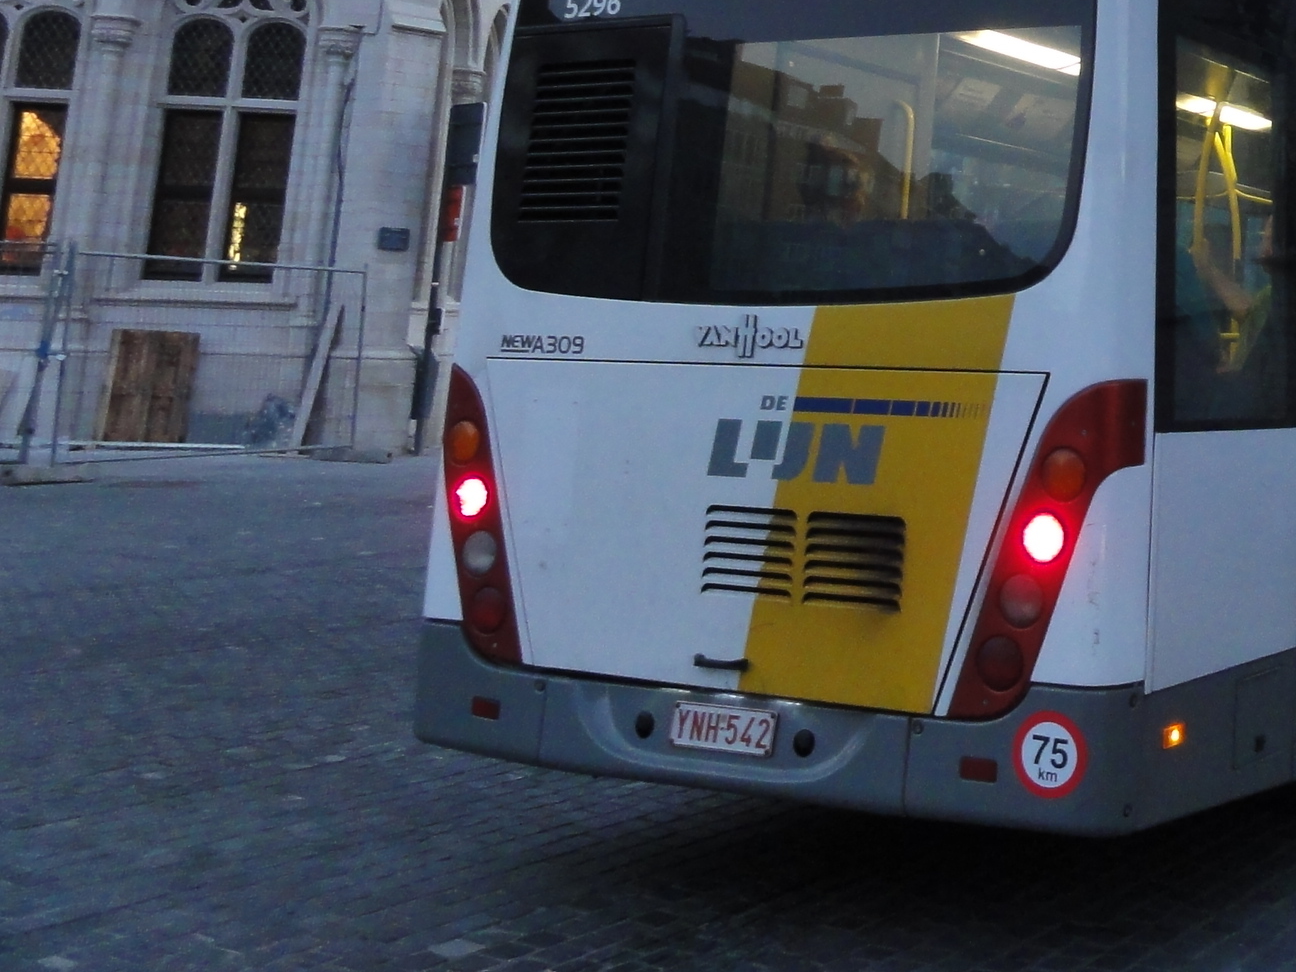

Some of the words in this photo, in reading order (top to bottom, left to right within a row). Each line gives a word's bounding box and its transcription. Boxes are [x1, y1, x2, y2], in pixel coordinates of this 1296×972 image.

[760, 395, 789, 411] DE
[706, 418, 887, 485] LIJN
[1032, 734, 1069, 769] 75
[1038, 767, 1058, 783] km
